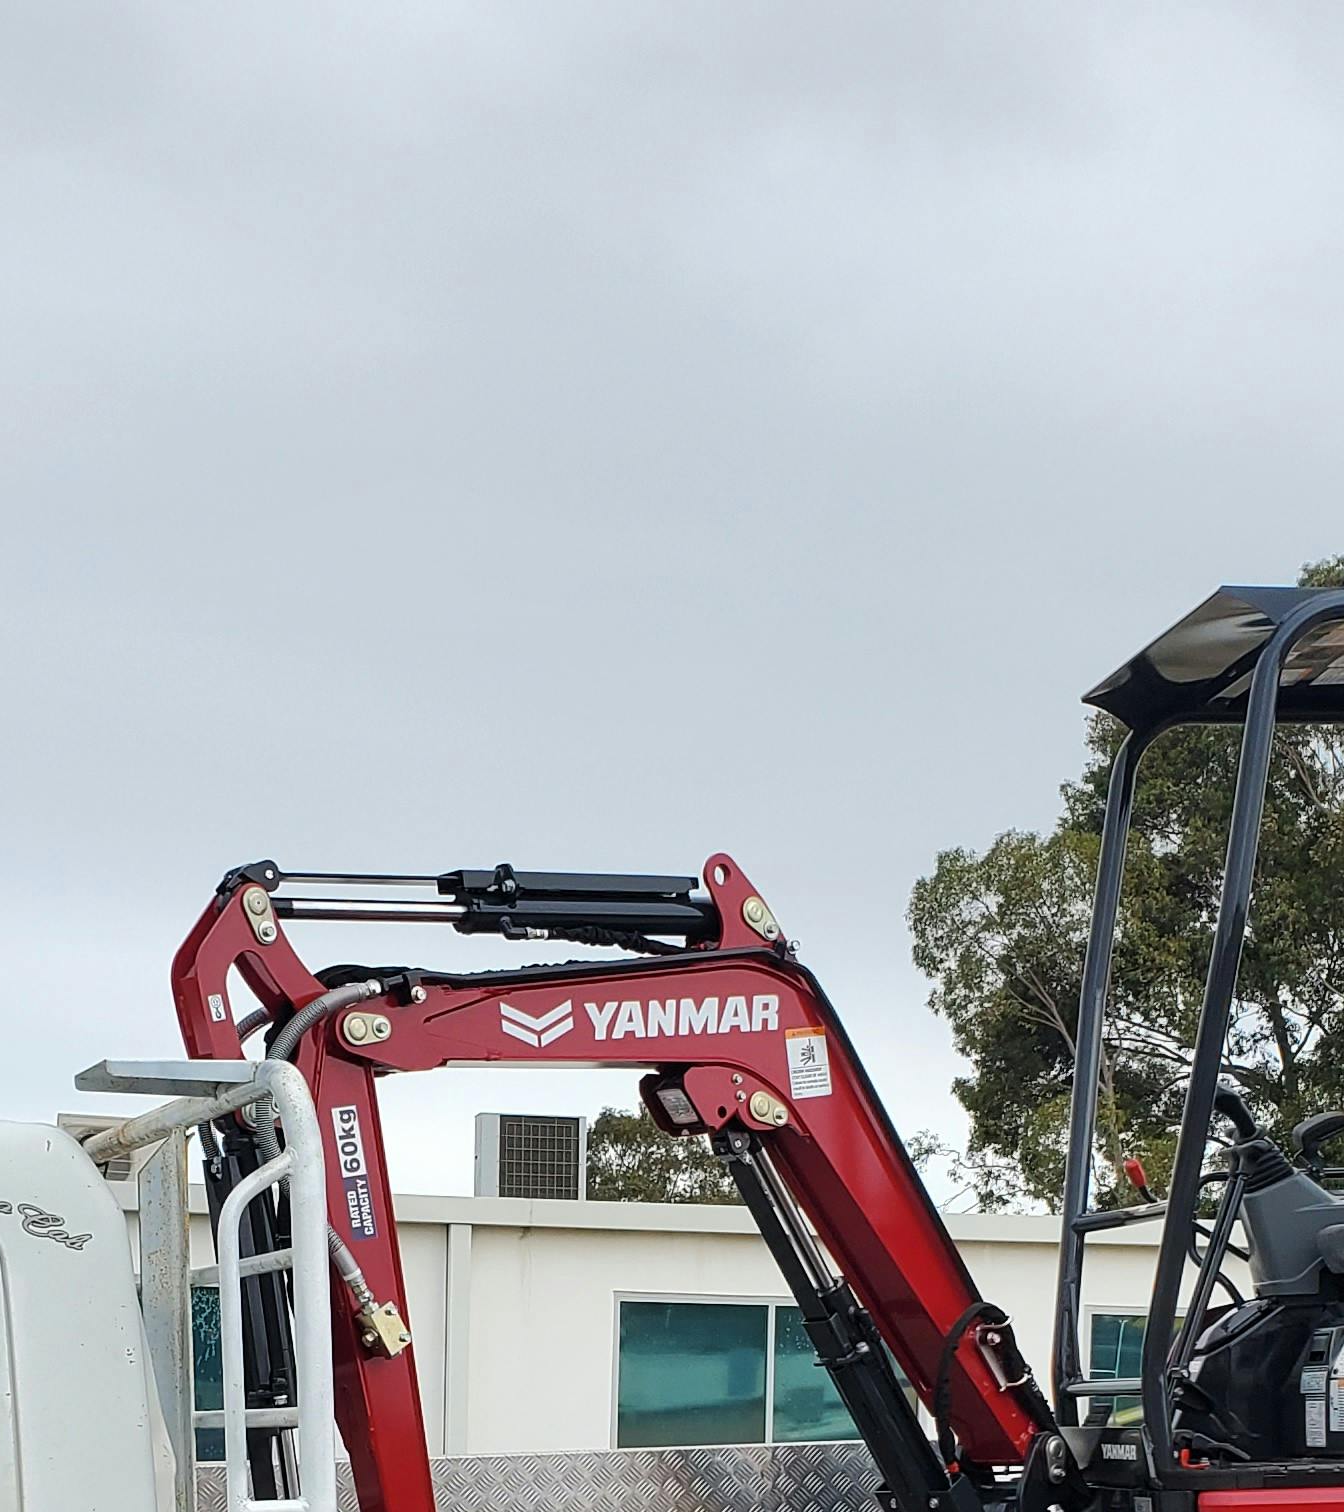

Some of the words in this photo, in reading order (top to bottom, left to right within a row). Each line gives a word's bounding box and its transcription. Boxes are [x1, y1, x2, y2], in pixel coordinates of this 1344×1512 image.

[584, 994, 779, 1041] YANMAR
[338, 1108, 362, 1174] 60kg
[17, 1203, 92, 1250] Cab
[347, 1190, 360, 1228] RATED
[356, 1179, 374, 1235] CAPACITY
[1101, 1443, 1137, 1461] YANMAR
